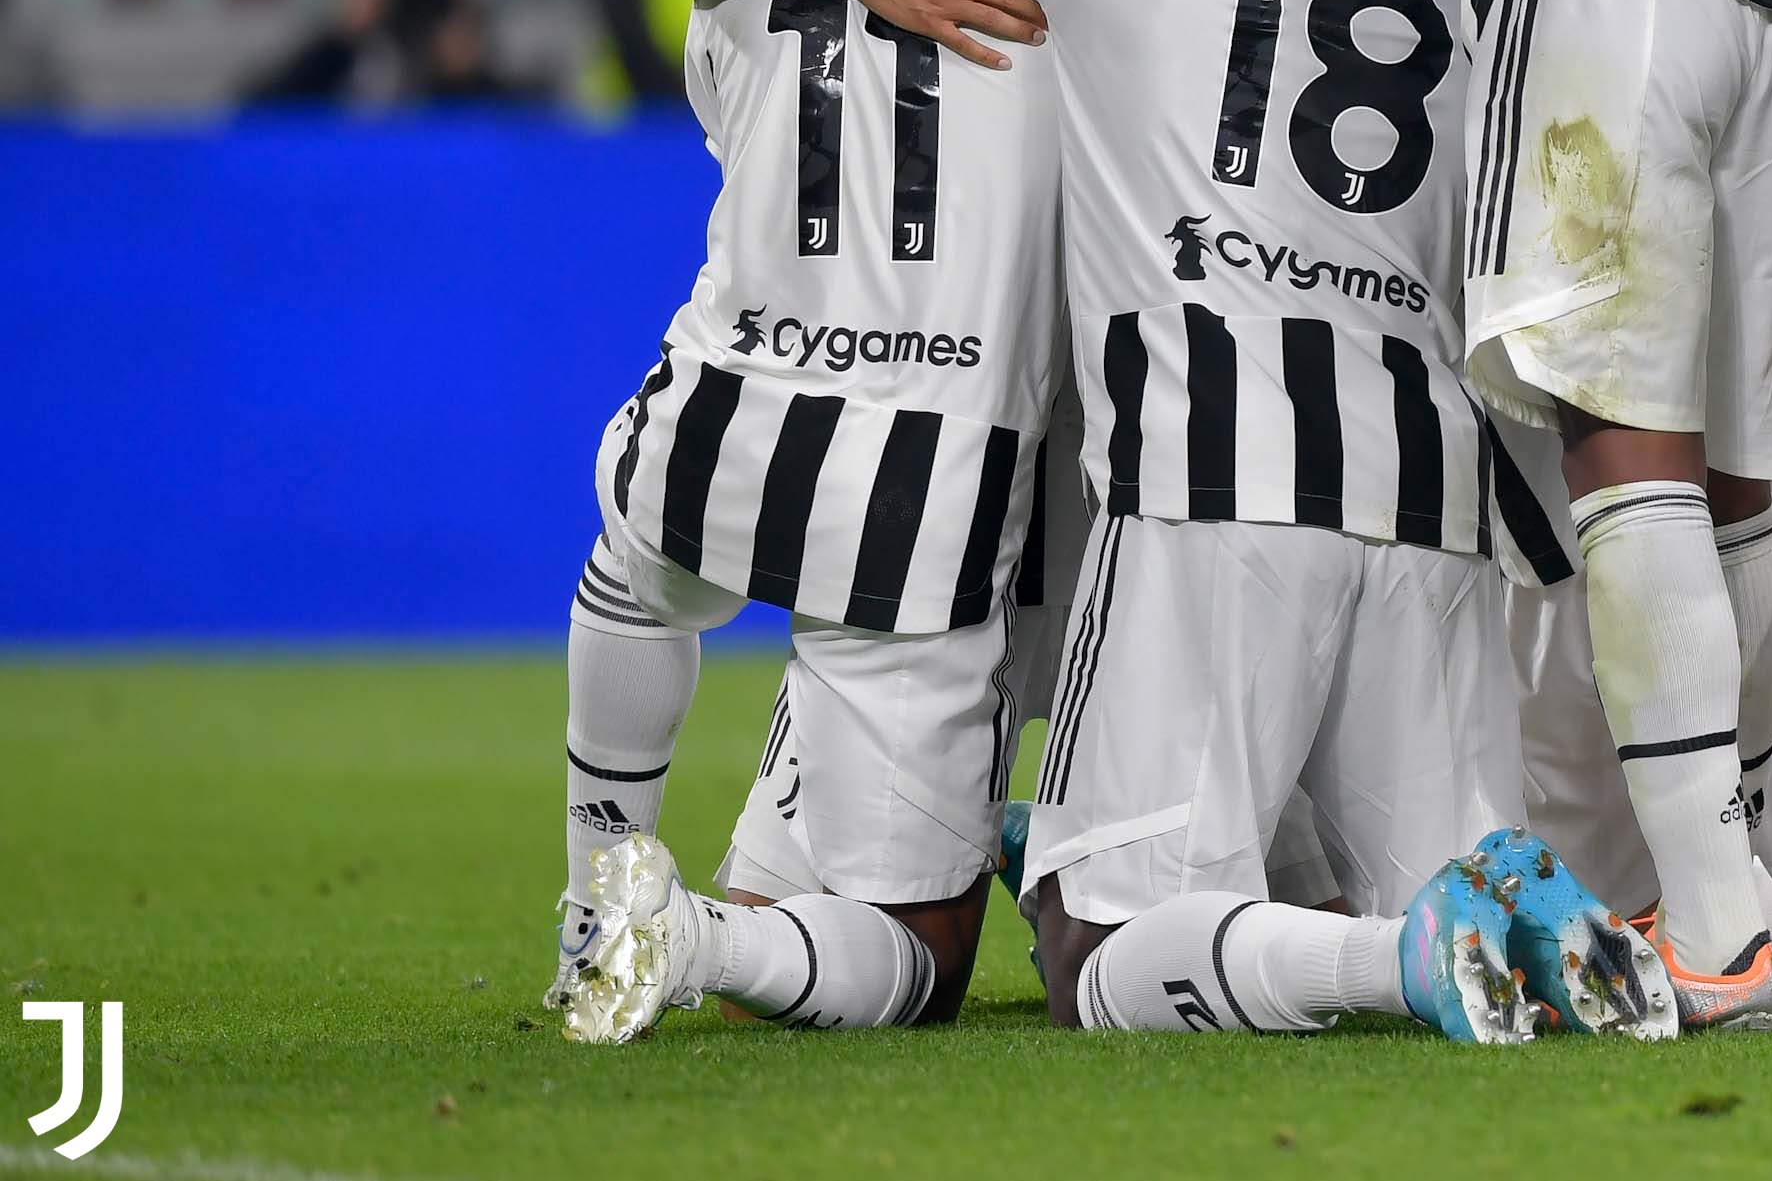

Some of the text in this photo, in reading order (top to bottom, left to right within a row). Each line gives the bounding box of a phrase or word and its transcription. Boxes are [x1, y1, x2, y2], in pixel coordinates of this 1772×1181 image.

[1215, 230, 1430, 314] Cygames
[772, 317, 982, 372] Cygames
[569, 805, 640, 834] adidas
